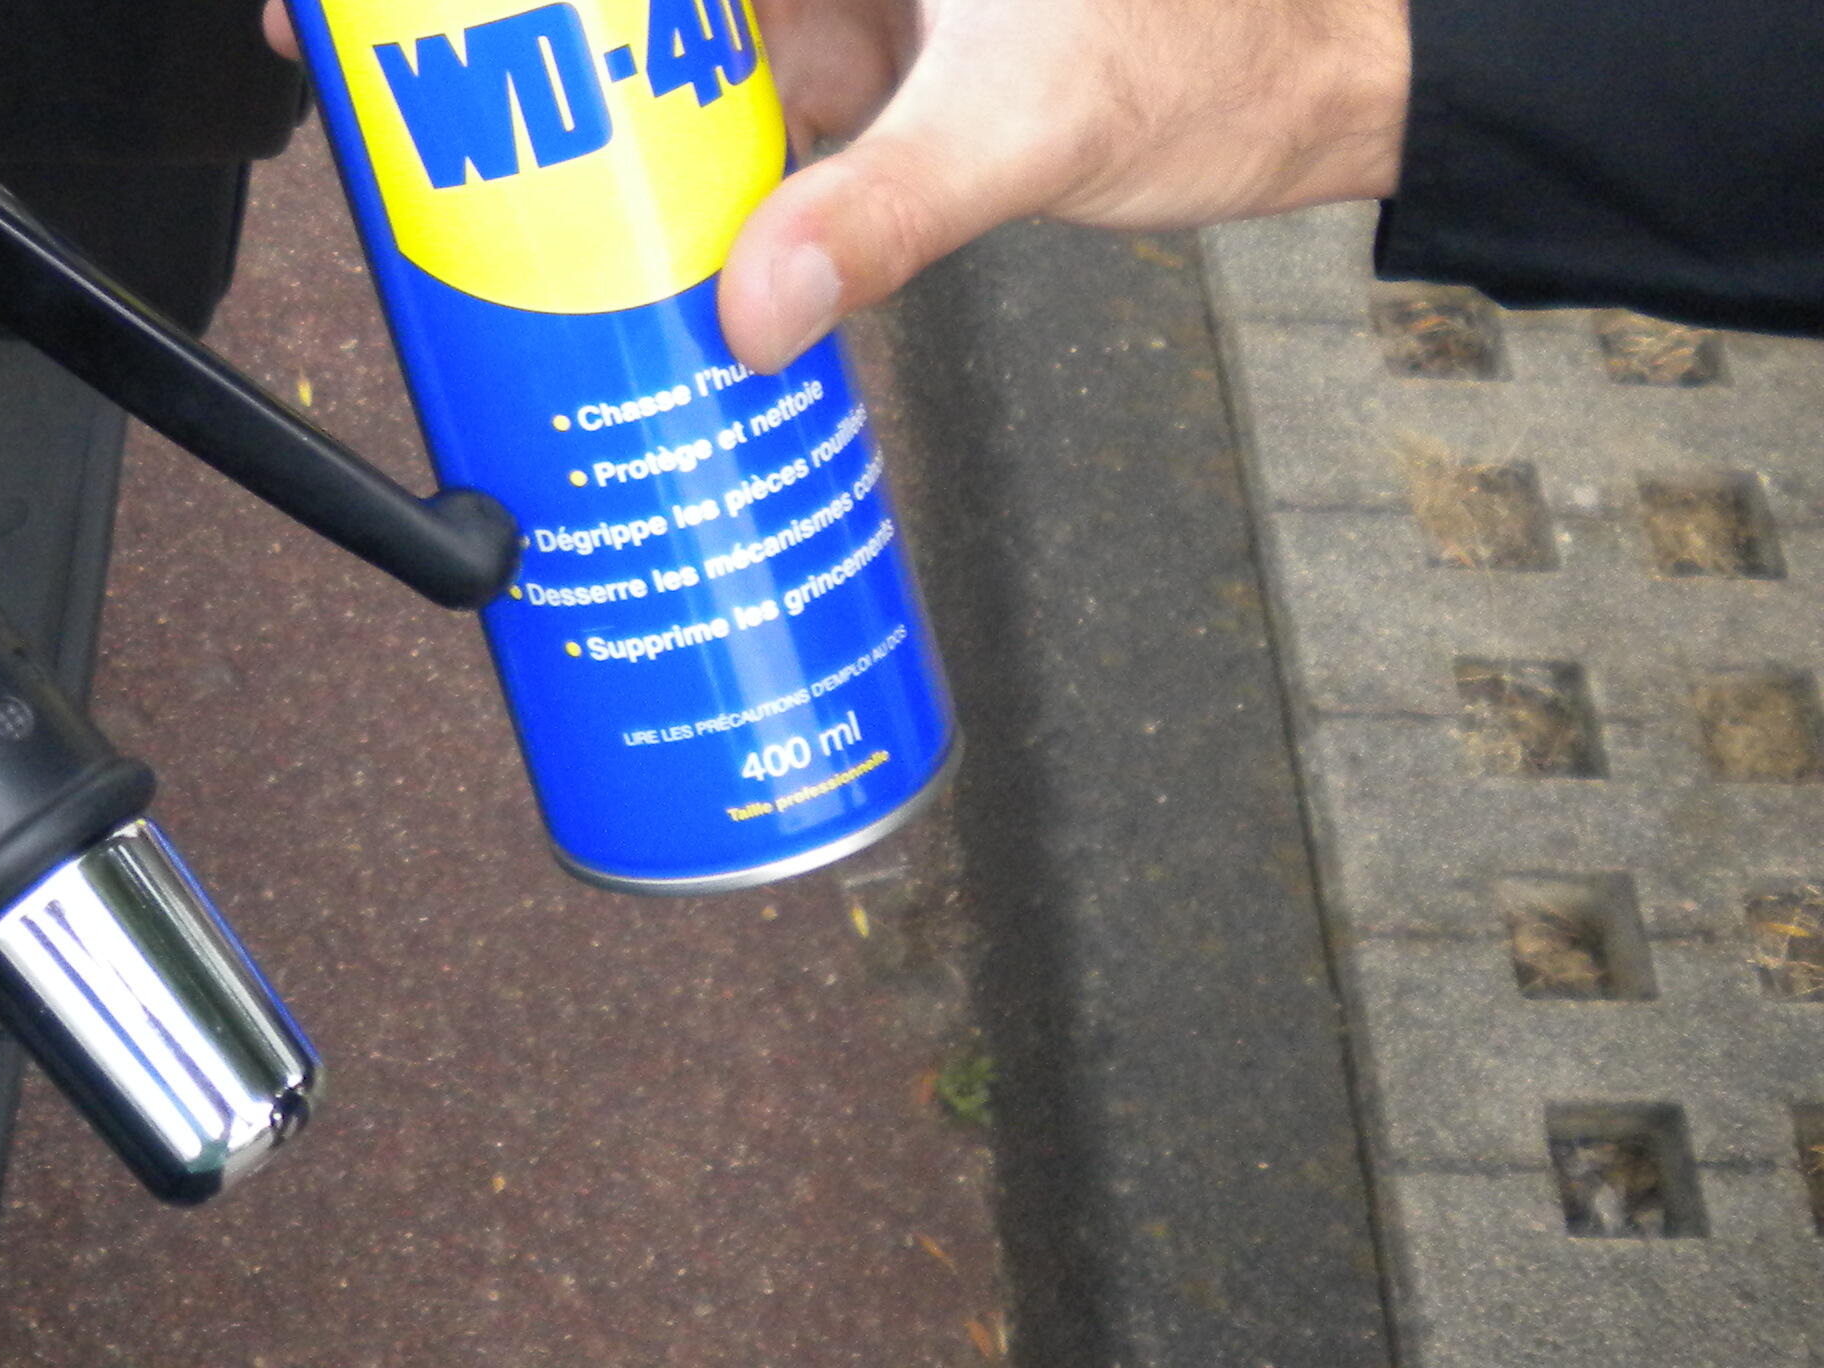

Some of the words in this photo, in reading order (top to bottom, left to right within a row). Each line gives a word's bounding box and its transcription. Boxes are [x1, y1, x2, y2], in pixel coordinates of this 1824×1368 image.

[577, 385, 692, 431] Chasse
[694, 362, 755, 398] l'hu
[592, 439, 713, 488] Protège
[717, 421, 748, 451] et
[749, 380, 824, 437] nettoie
[525, 579, 649, 607] Desserre
[651, 566, 700, 593] les
[703, 492, 854, 580] mécanismes
[534, 516, 668, 556] Dégrippe
[672, 499, 721, 529] les
[724, 458, 810, 518] pièces
[586, 618, 730, 664] Supprime
[733, 599, 780, 631] les
[783, 518, 895, 617] grincements
[623, 729, 660, 747] LIRE
[661, 724, 695, 743] LES
[694, 687, 812, 737] PRÉCAUTIONS
[810, 653, 873, 698] D'EMPLOI
[740, 735, 813, 782] 400
[817, 709, 864, 757] ml
[726, 801, 774, 823] Taille
